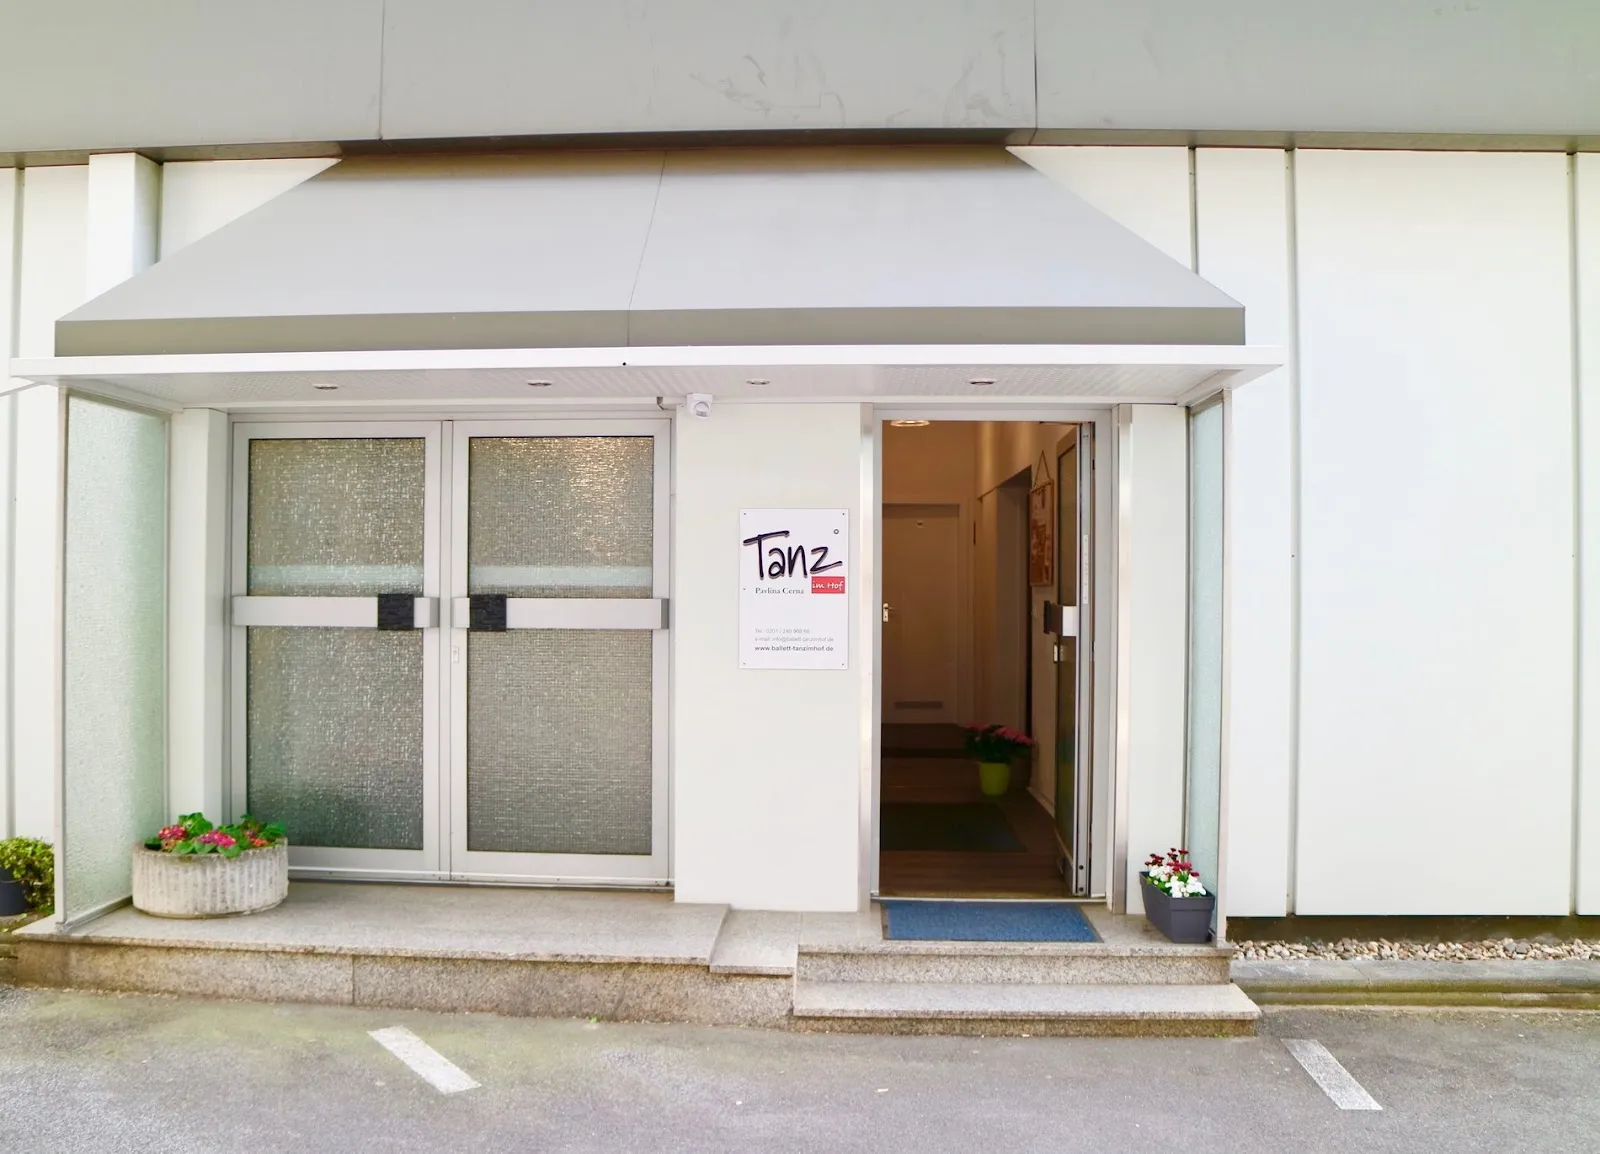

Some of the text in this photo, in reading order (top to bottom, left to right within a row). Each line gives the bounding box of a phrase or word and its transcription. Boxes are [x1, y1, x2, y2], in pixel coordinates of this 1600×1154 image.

[743, 530, 843, 580] Tanz
[812, 580, 844, 591] im Hof
[755, 587, 804, 595] Pavlina Cerna
[755, 644, 834, 652] www.ballett-tanzimhof.de
